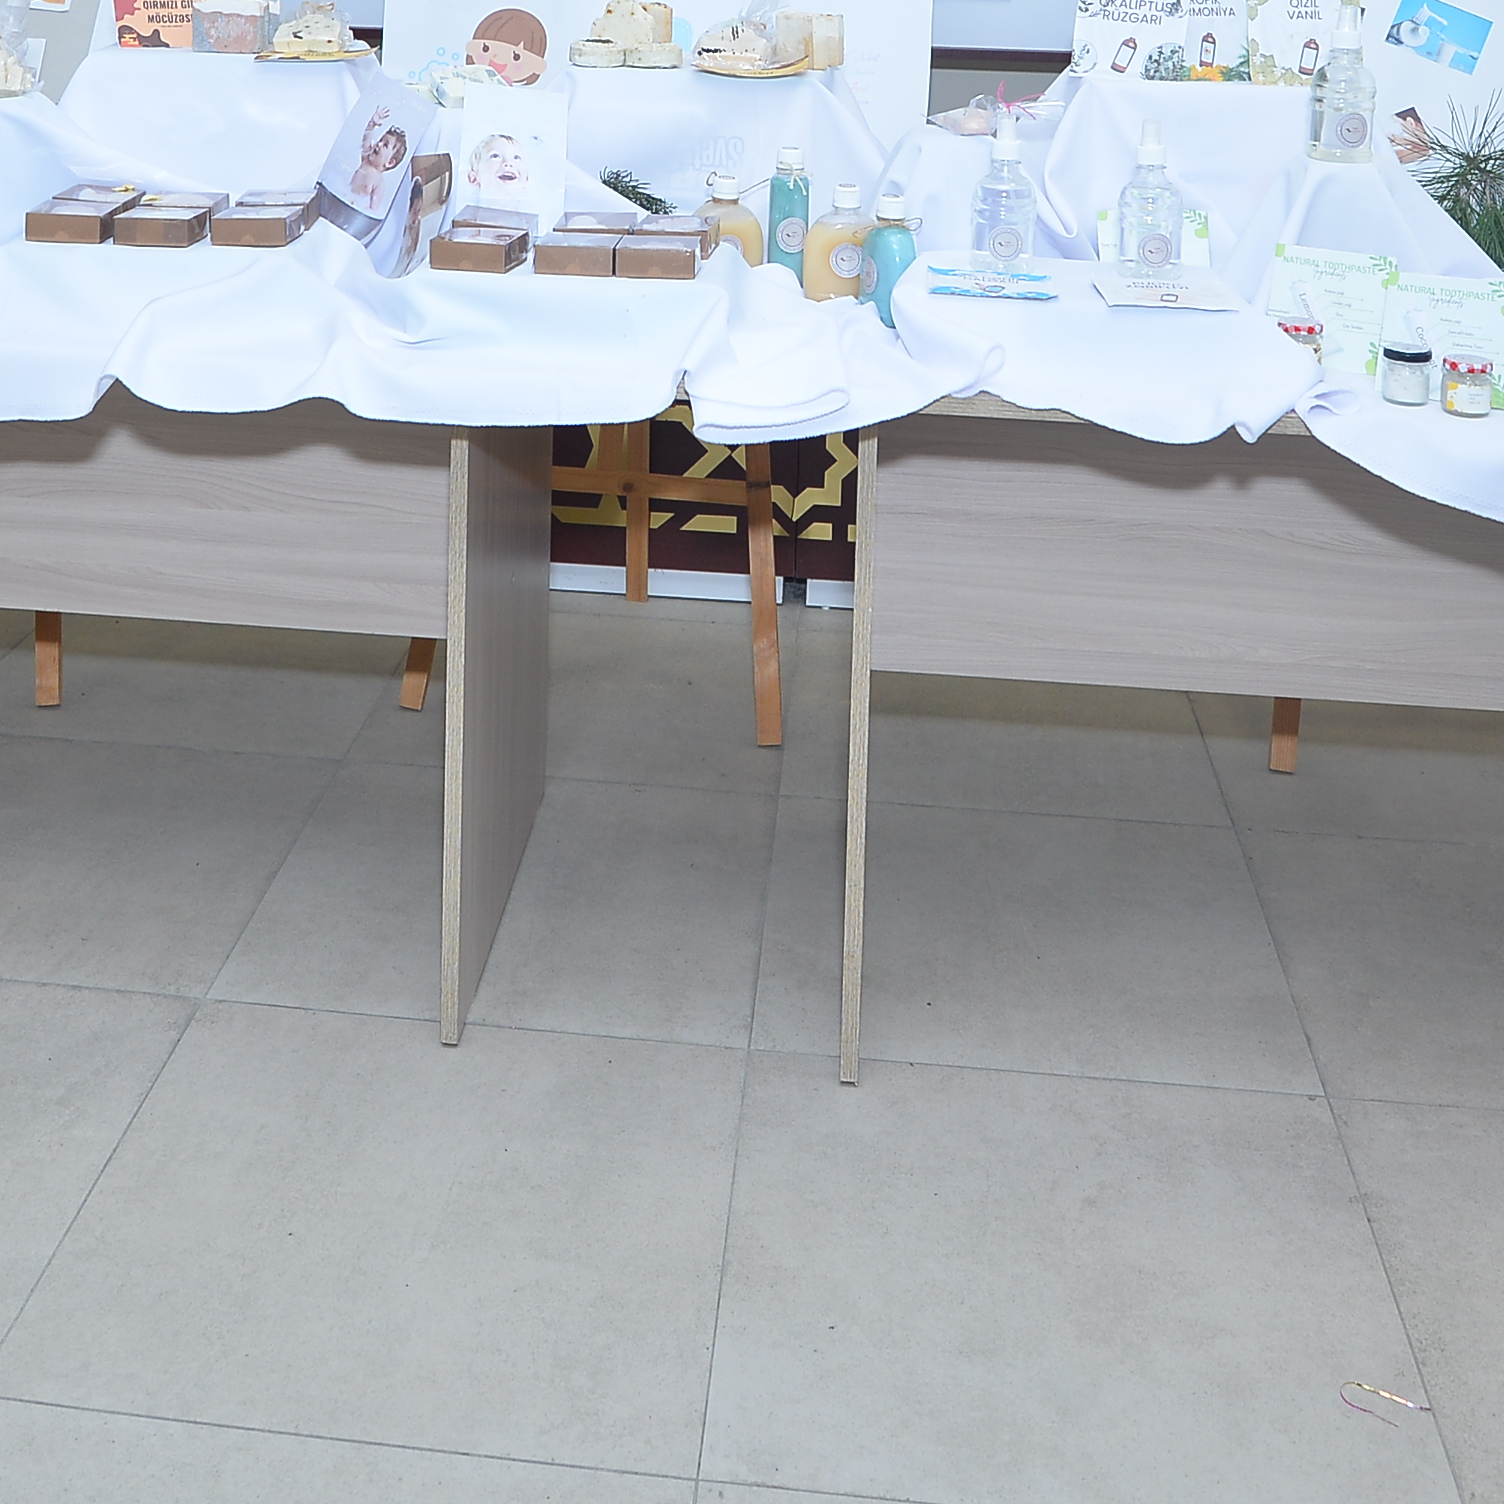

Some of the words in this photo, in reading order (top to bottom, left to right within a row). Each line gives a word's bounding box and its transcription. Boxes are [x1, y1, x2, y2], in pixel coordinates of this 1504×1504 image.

[147, 10, 193, 25] MÖCÜZƏS
[1283, 255, 1320, 268] NATURAL
[1324, 261, 1377, 276] TOOTHPASTE
[1397, 284, 1437, 296] NATURAL
[1440, 288, 1497, 302] TOOTHPASTE
[1298, 292, 1316, 321] Lemo
